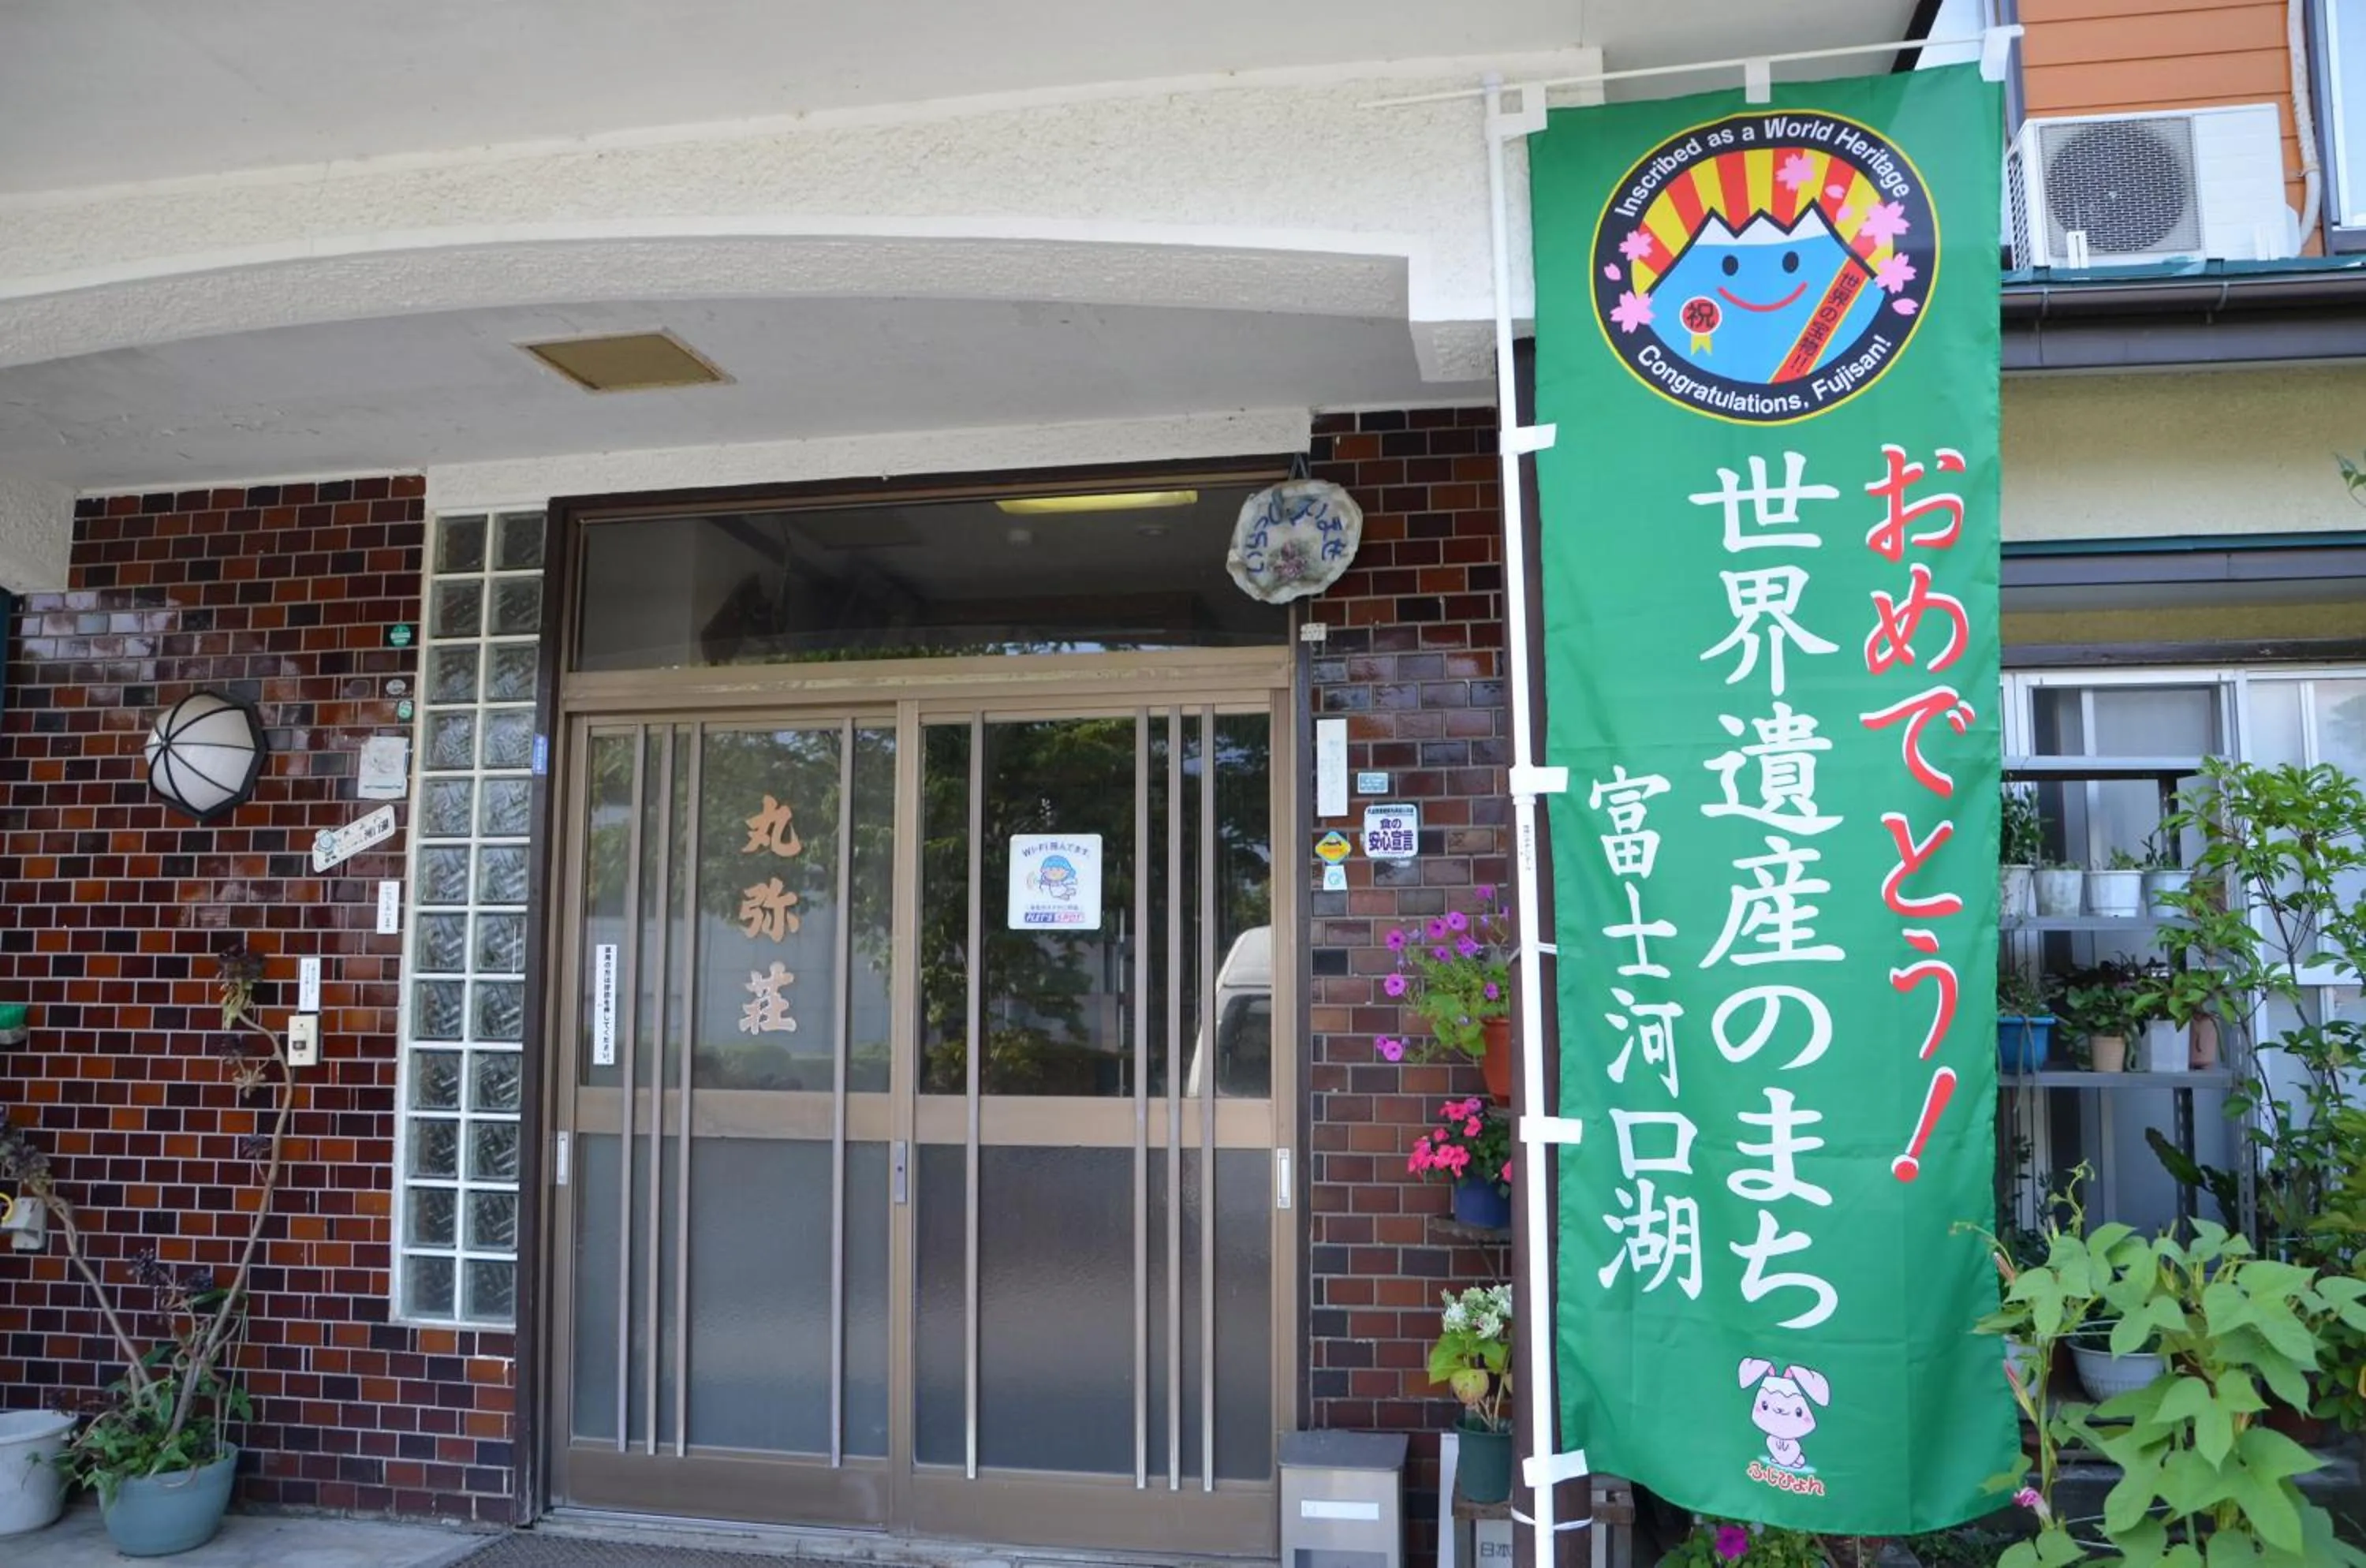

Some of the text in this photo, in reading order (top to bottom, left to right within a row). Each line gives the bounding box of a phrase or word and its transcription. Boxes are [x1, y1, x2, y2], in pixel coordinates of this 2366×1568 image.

[1614, 117, 1911, 219] Inscribed as a World Heritage
[1685, 301, 1716, 330] 祝
[1637, 334, 1892, 414] Congratulations, Fujisan!
[1368, 830, 1413, 851] 安心宣言
[1380, 818, 1401, 829] 食の
[1859, 443, 1976, 1183] おめでとう！
[738, 794, 802, 1036] 丸弥荘
[1689, 450, 1847, 1330] 世界遺産のまち
[1589, 765, 1703, 1301] 富士河口湖
